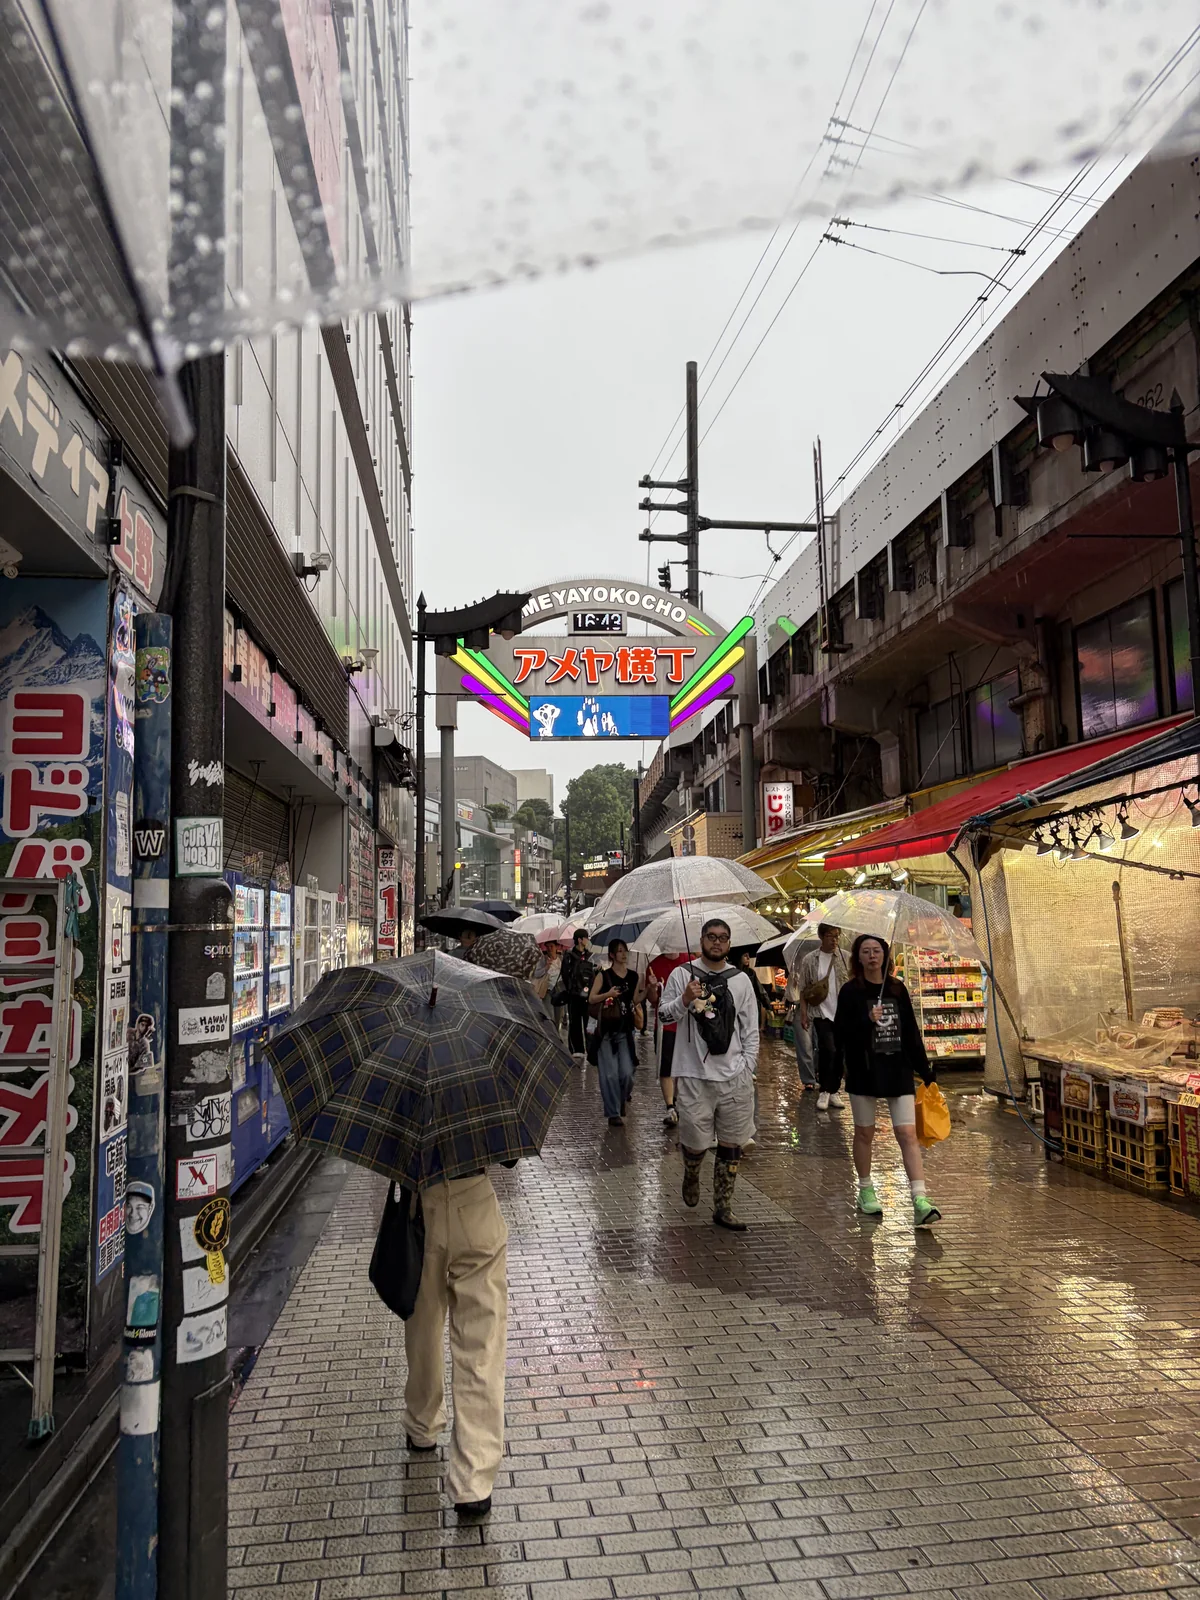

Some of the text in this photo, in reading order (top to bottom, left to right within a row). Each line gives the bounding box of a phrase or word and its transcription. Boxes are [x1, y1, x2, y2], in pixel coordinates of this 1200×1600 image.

[112, 487, 154, 594] 上野
[522, 586, 687, 624] MEYAYOKOCHO
[513, 646, 696, 684] アメヤ横丁
[136, 829, 165, 856] W
[182, 821, 221, 848] CURVA
[184, 846, 220, 870] NORD!
[204, 1024, 225, 1034] 5000
